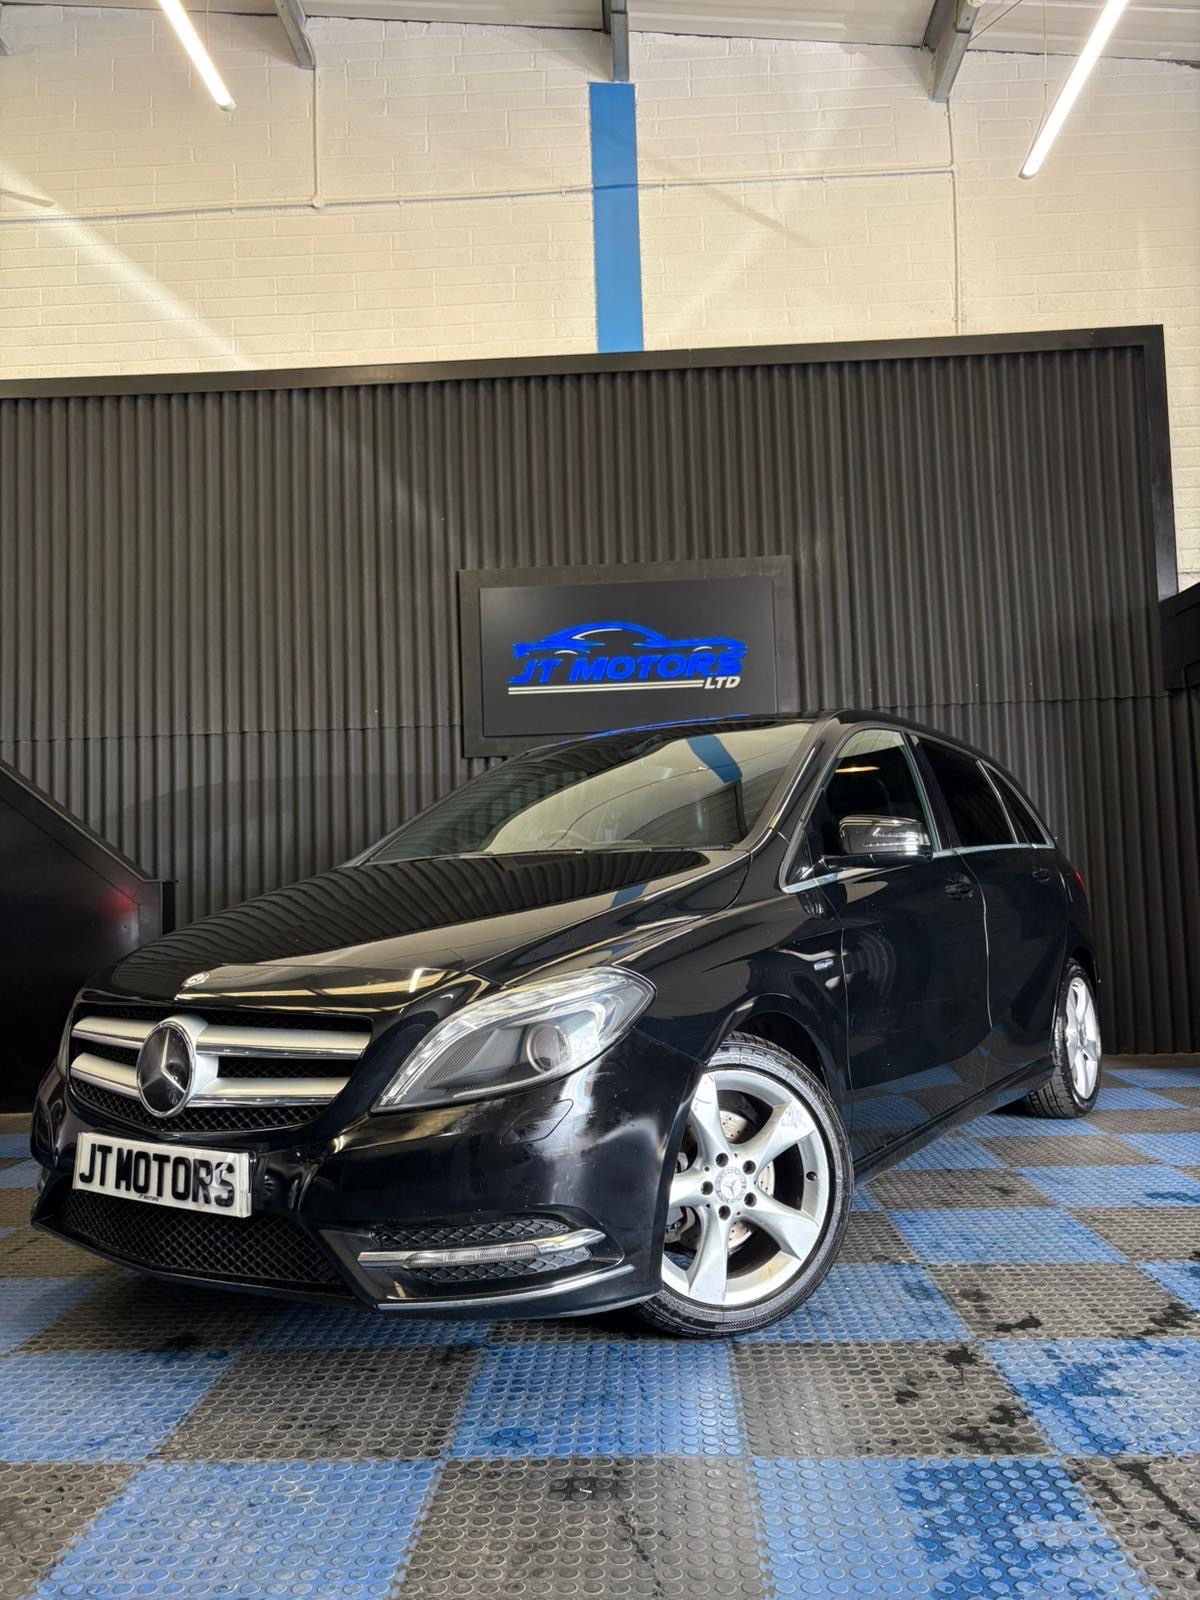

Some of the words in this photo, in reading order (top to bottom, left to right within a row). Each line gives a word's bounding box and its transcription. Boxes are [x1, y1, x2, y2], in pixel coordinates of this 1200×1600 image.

[508, 659, 563, 684] JT
[569, 652, 746, 683] MOTORS
[704, 676, 741, 689] LTD
[79, 1143, 112, 1186] JT
[115, 1147, 235, 1207] MOTORS
